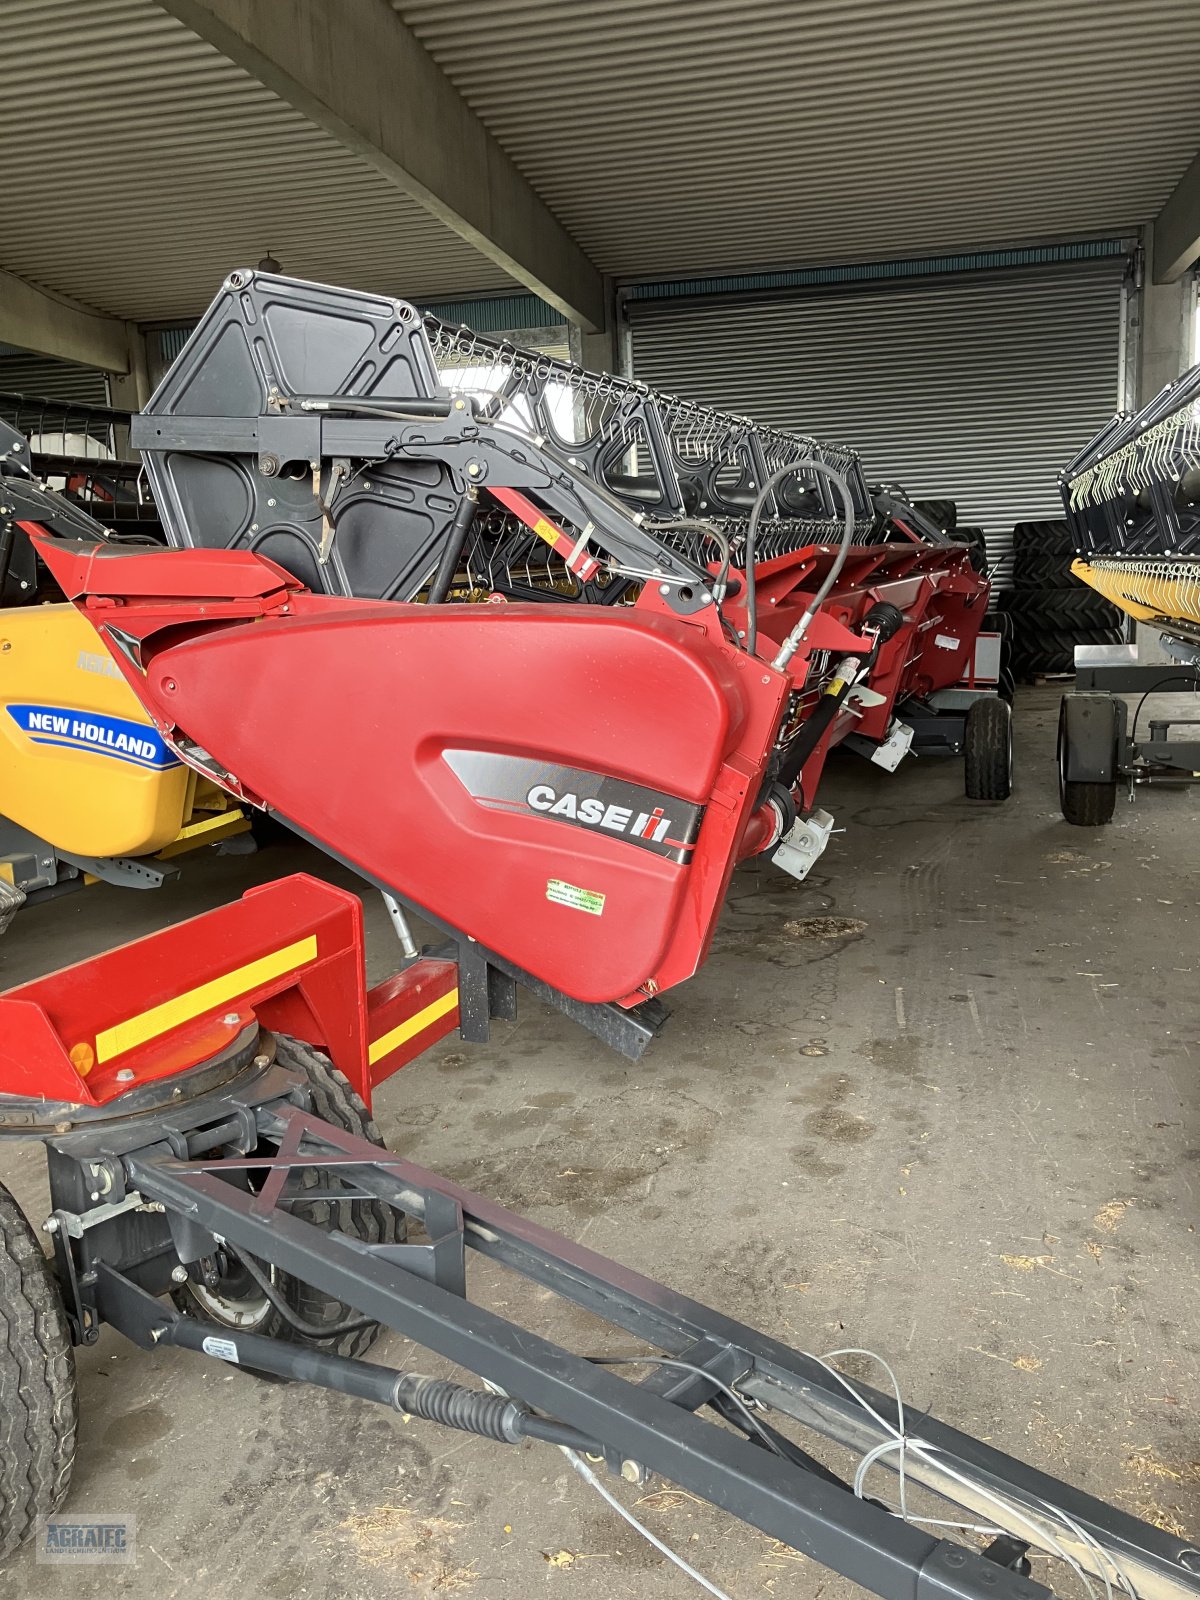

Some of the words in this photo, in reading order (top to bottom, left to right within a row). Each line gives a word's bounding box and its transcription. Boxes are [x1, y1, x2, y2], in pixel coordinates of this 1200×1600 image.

[29, 712, 69, 734] NEW
[73, 721, 156, 759] HOLLAND
[527, 785, 633, 832] CASE
